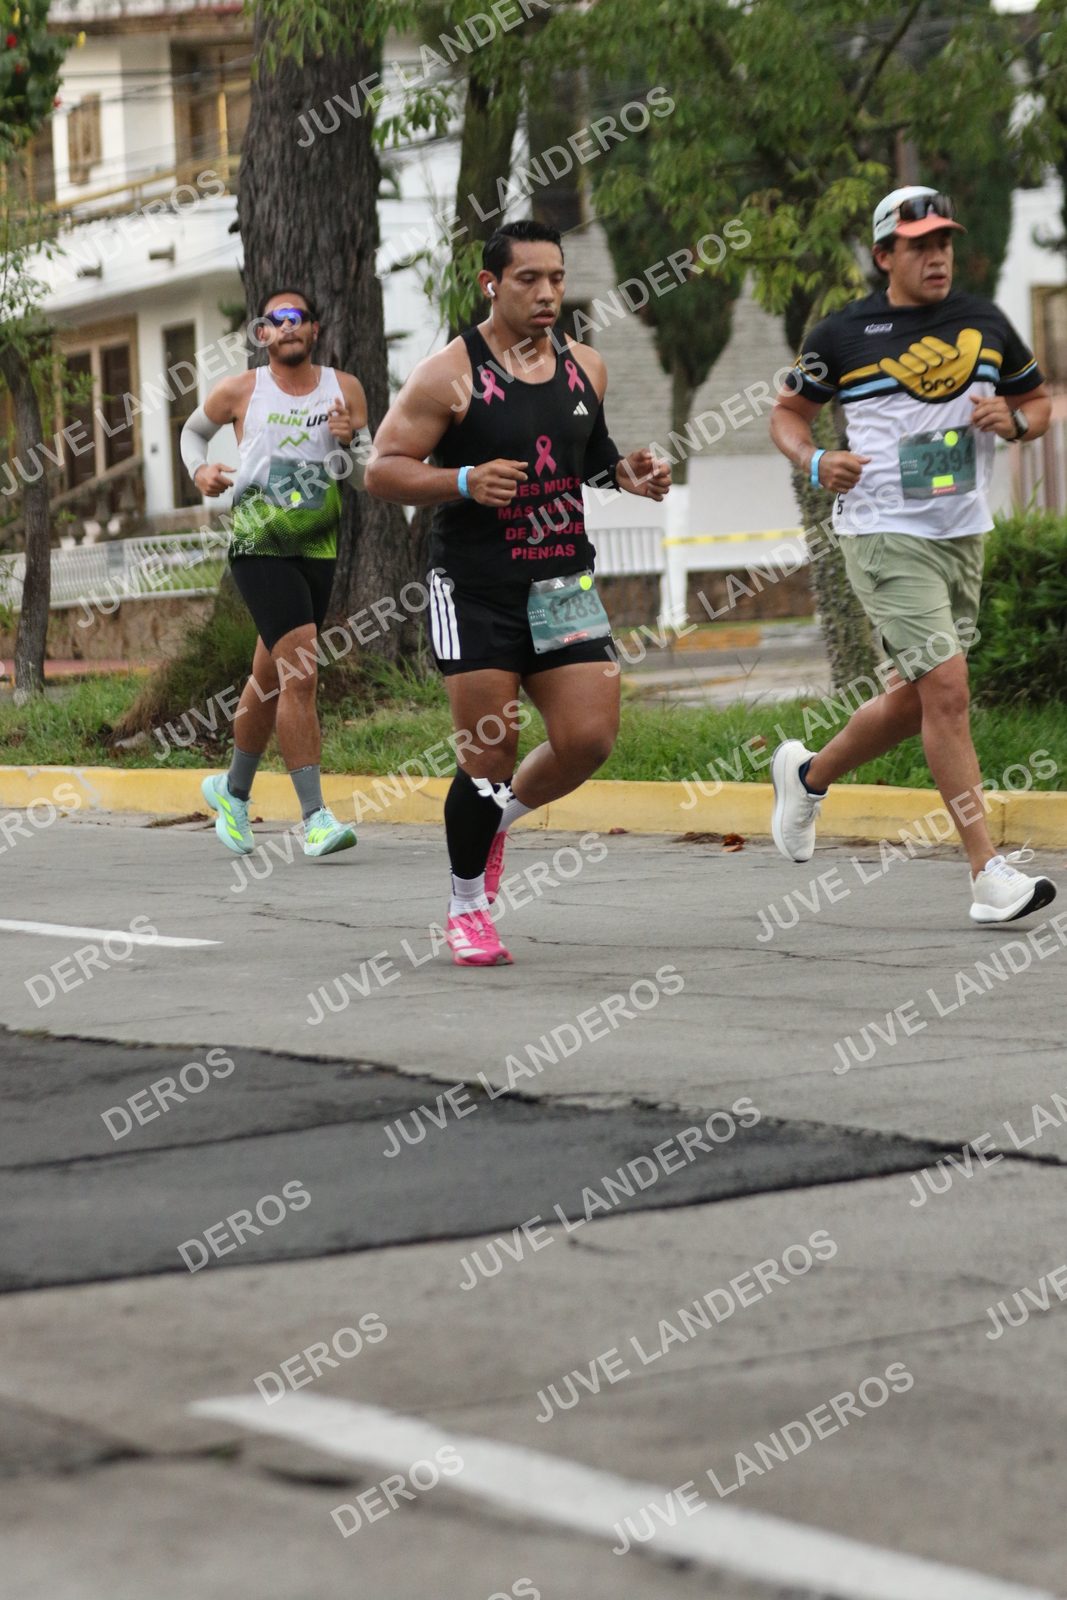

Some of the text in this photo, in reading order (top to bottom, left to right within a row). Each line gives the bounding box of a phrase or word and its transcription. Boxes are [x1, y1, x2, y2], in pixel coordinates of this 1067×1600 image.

[920, 375, 955, 393] bro
[267, 413, 329, 427] RUN UP
[515, 484, 540, 498] ES
[505, 526, 527, 541] DE
